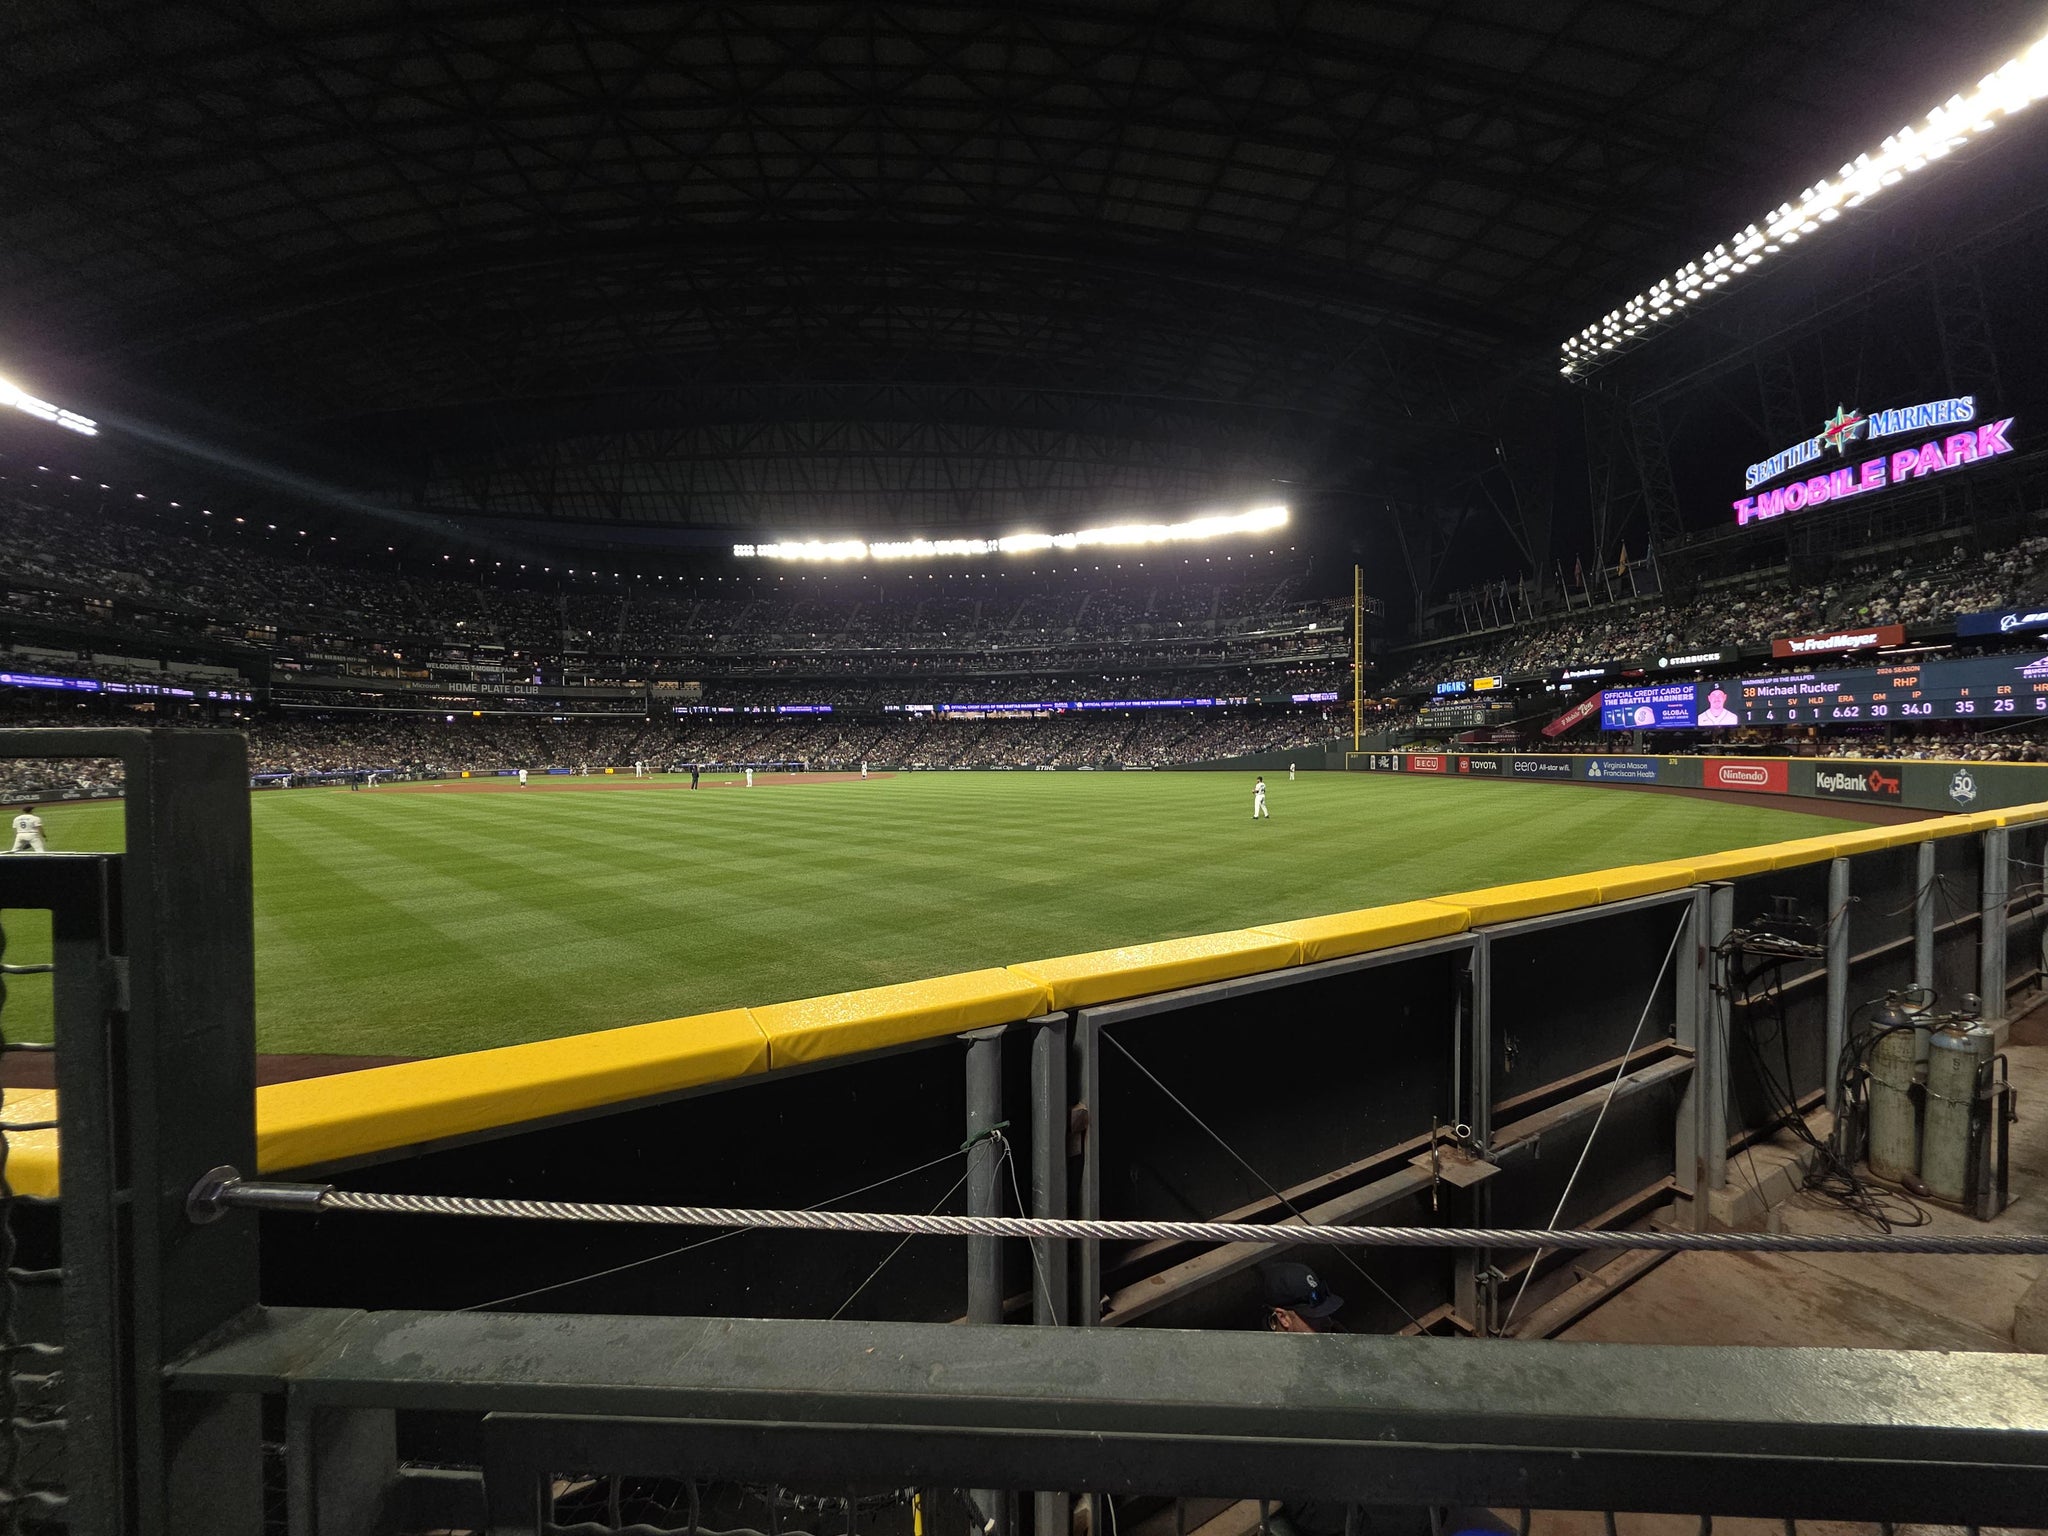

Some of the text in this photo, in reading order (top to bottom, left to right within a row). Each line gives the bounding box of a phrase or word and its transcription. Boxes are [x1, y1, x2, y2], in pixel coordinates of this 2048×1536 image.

[1746, 396, 1974, 490] SEATTLE MARINERS
[1733, 417, 2015, 525] T-MOBILE PARK
[1670, 653, 1720, 665] STARBUCKS
[1893, 666, 1920, 674] SEASON
[1893, 677, 1918, 687] RHP
[448, 682, 477, 692] HOME
[482, 684, 510, 694] PLATE
[514, 686, 538, 694] CLUB
[1604, 690, 1632, 699] OFFICIAL
[1634, 688, 1659, 697] CREDIT
[1743, 682, 1840, 698] 38 Michael Rucker
[1652, 694, 1694, 702] MARINERS
[2036, 697, 2046, 710] 5
[1871, 705, 1888, 716] 30
[1902, 702, 1932, 714] 34.0
[1955, 701, 1974, 713] 35
[1994, 699, 2014, 712] 25
[1747, 712, 1751, 720] 1
[1766, 710, 1774, 720] 4
[1789, 709, 1796, 719] 0
[1813, 708, 1818, 718] 1
[1832, 706, 1859, 717] 6.62
[1416, 759, 1437, 767] BECU
[1471, 761, 1496, 770] TOYOTA
[1515, 761, 1538, 772] eero
[1603, 762, 1626, 770] Virginia
[1723, 770, 1763, 781] Nintendo
[1816, 772, 1867, 792] KeyBank
[1955, 776, 1971, 791] 50
